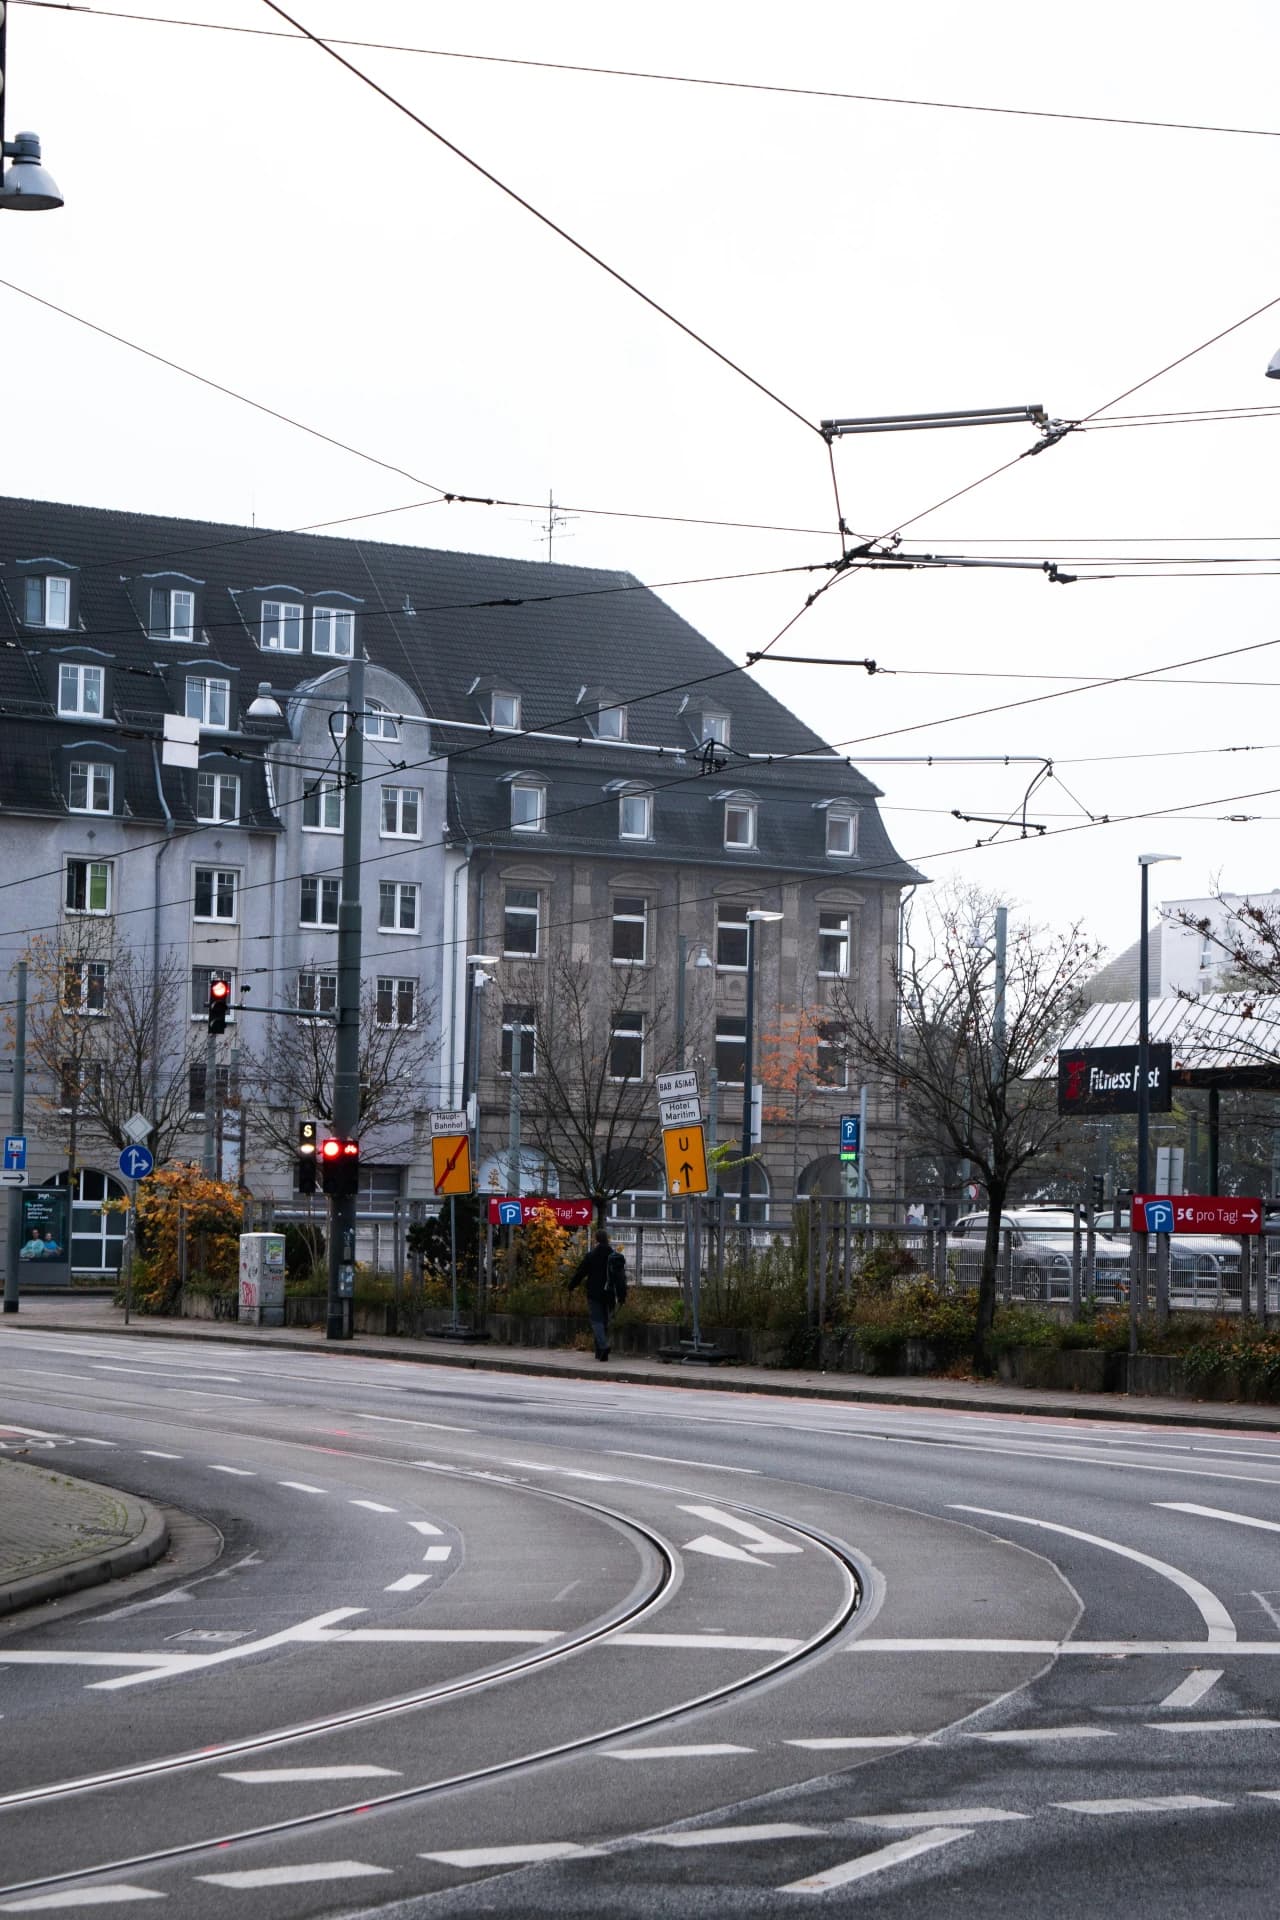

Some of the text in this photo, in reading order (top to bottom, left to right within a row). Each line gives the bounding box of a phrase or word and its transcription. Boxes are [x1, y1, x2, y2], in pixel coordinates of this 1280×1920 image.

[1089, 1065, 1159, 1094] Fitness Fst
[670, 1102, 690, 1110] Hotel
[436, 1112, 460, 1121] Haupt-
[665, 1111, 696, 1120] Maritim
[303, 1124, 313, 1138] S
[434, 1121, 463, 1130] Bahnhof
[679, 1136, 688, 1151] U
[556, 1207, 573, 1219] Tag!
[1177, 1208, 1194, 1220] 5€
[1196, 1210, 1215, 1224] pro
[1217, 1208, 1239, 1225] Tag!
